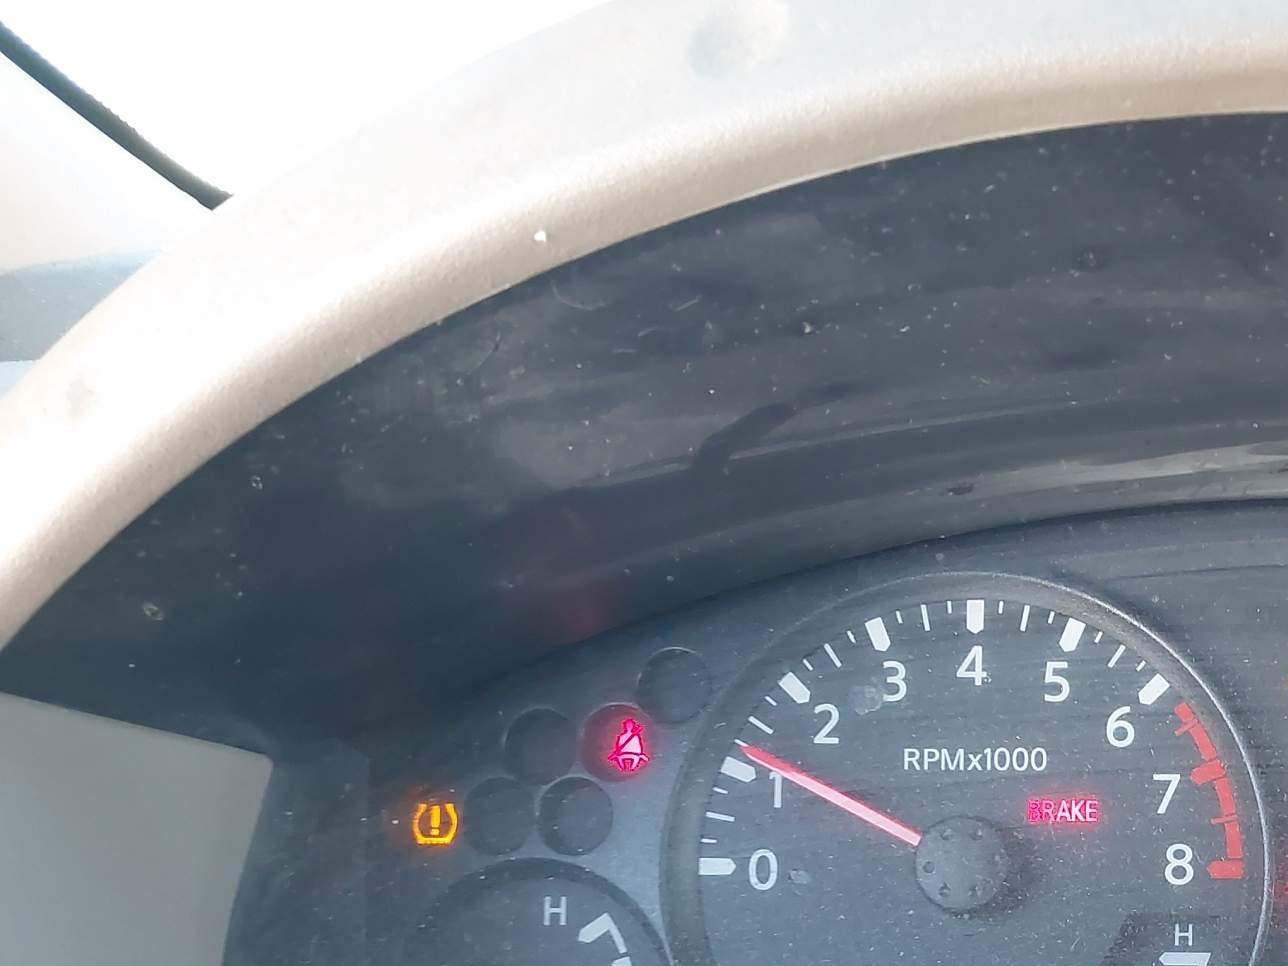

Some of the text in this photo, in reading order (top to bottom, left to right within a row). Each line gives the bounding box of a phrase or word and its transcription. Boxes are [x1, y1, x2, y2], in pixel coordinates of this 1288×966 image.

[882, 660, 908, 703] 3
[956, 644, 989, 687] 4
[1043, 661, 1071, 703] 5
[813, 703, 840, 745] 2
[1106, 706, 1135, 748] 6
[902, 746, 1048, 772] RPMx1000
[768, 770, 783, 809] 1
[1152, 773, 1181, 815] 7
[1027, 799, 1099, 823] BRAKE
[748, 848, 779, 891] 0
[1163, 842, 1195, 886] 8
[543, 896, 568, 926] H
[1173, 923, 1194, 947] H
